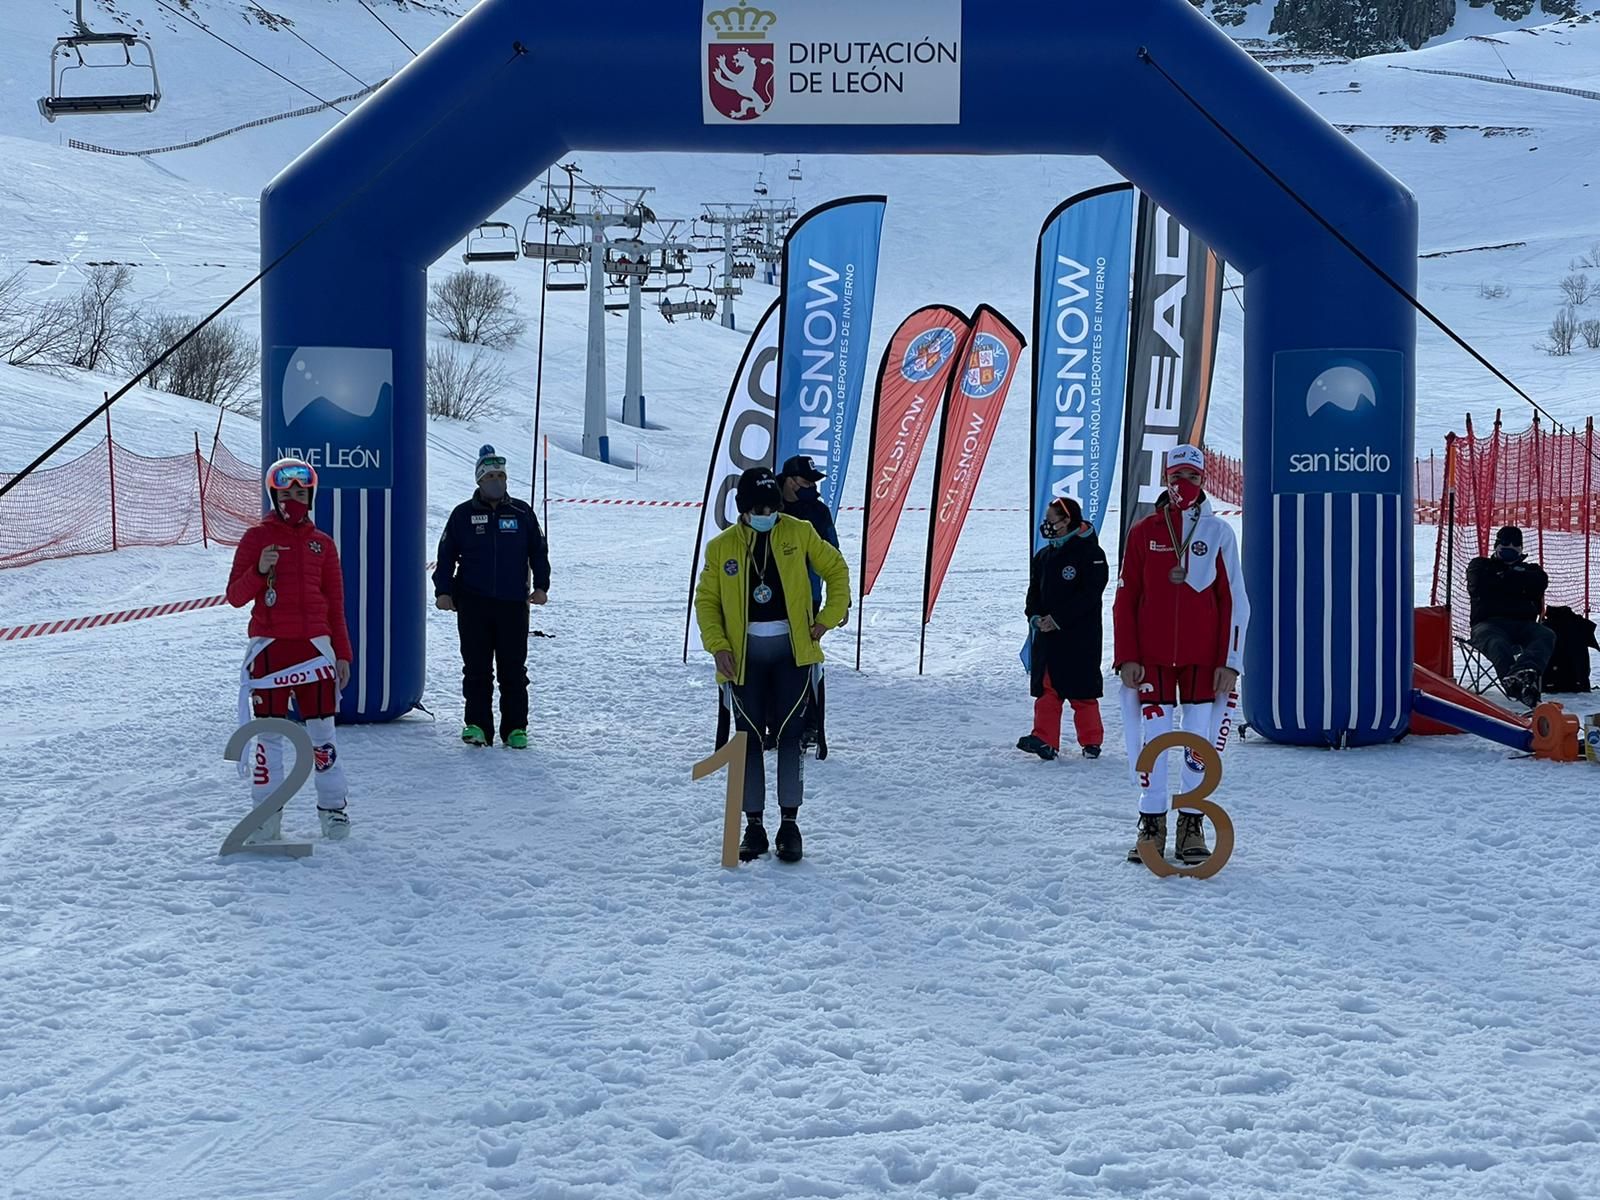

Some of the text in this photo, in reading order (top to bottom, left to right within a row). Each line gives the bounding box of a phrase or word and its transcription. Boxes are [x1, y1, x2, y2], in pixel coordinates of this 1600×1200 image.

[789, 36, 957, 64] DIPUTACIÓN
[789, 65, 903, 93] DE LEÓN
[842, 263, 855, 319] INVIERNO
[1095, 256, 1106, 313] INVIERNO
[841, 320, 850, 336] DE
[1094, 315, 1103, 331] DE
[837, 339, 849, 399] DEPORTES
[1091, 334, 1102, 395] DEPORTES
[326, 442, 380, 468] LEÓN
[832, 401, 844, 462] ESPAÑOLA
[1089, 398, 1101, 459] ESPAÑOLA
[1289, 446, 1391, 473] san isidro
[218, 717, 317, 858] 2
[692, 730, 748, 868] 1
[1135, 730, 1235, 880] 3
